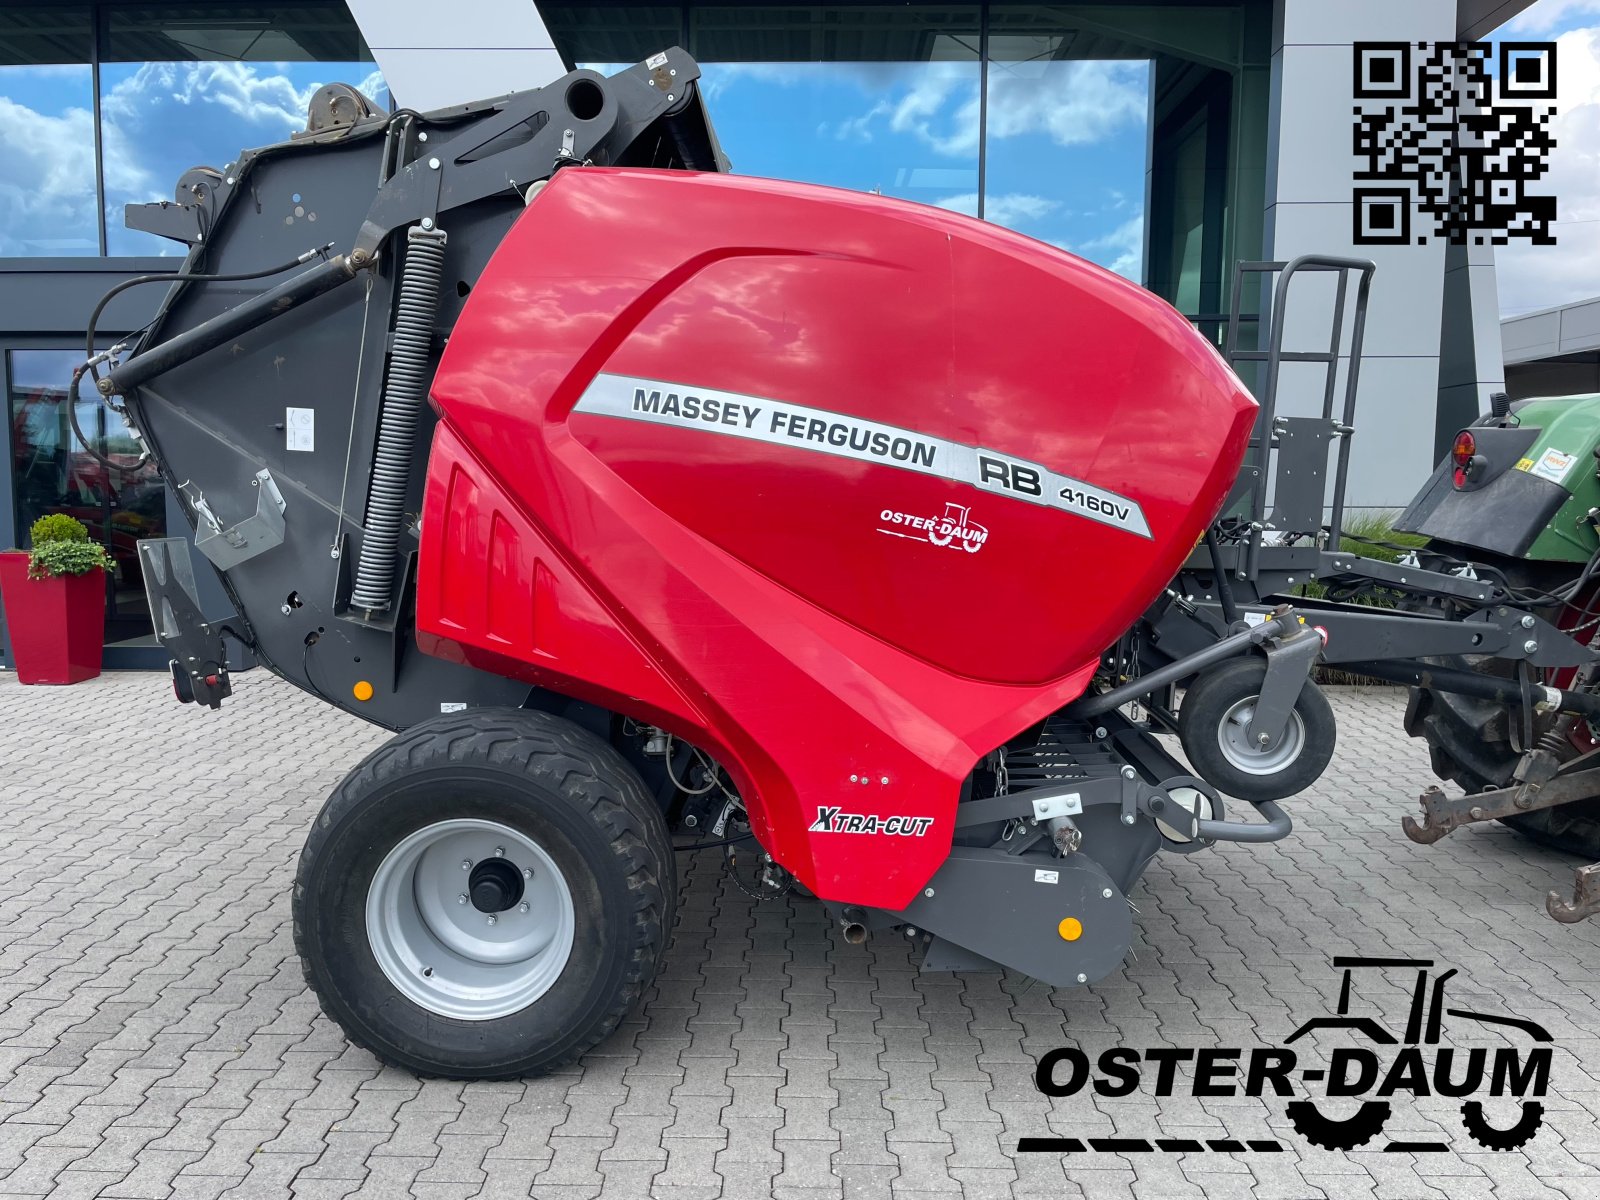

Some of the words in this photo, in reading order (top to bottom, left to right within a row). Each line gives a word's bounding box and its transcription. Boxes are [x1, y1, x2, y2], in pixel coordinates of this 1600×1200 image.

[632, 388, 762, 429] MASSEY
[769, 411, 937, 468] FERGUSON
[979, 455, 1042, 497] RB
[1059, 487, 1130, 521] 4160V
[880, 509, 989, 544] OSTER-DAUM
